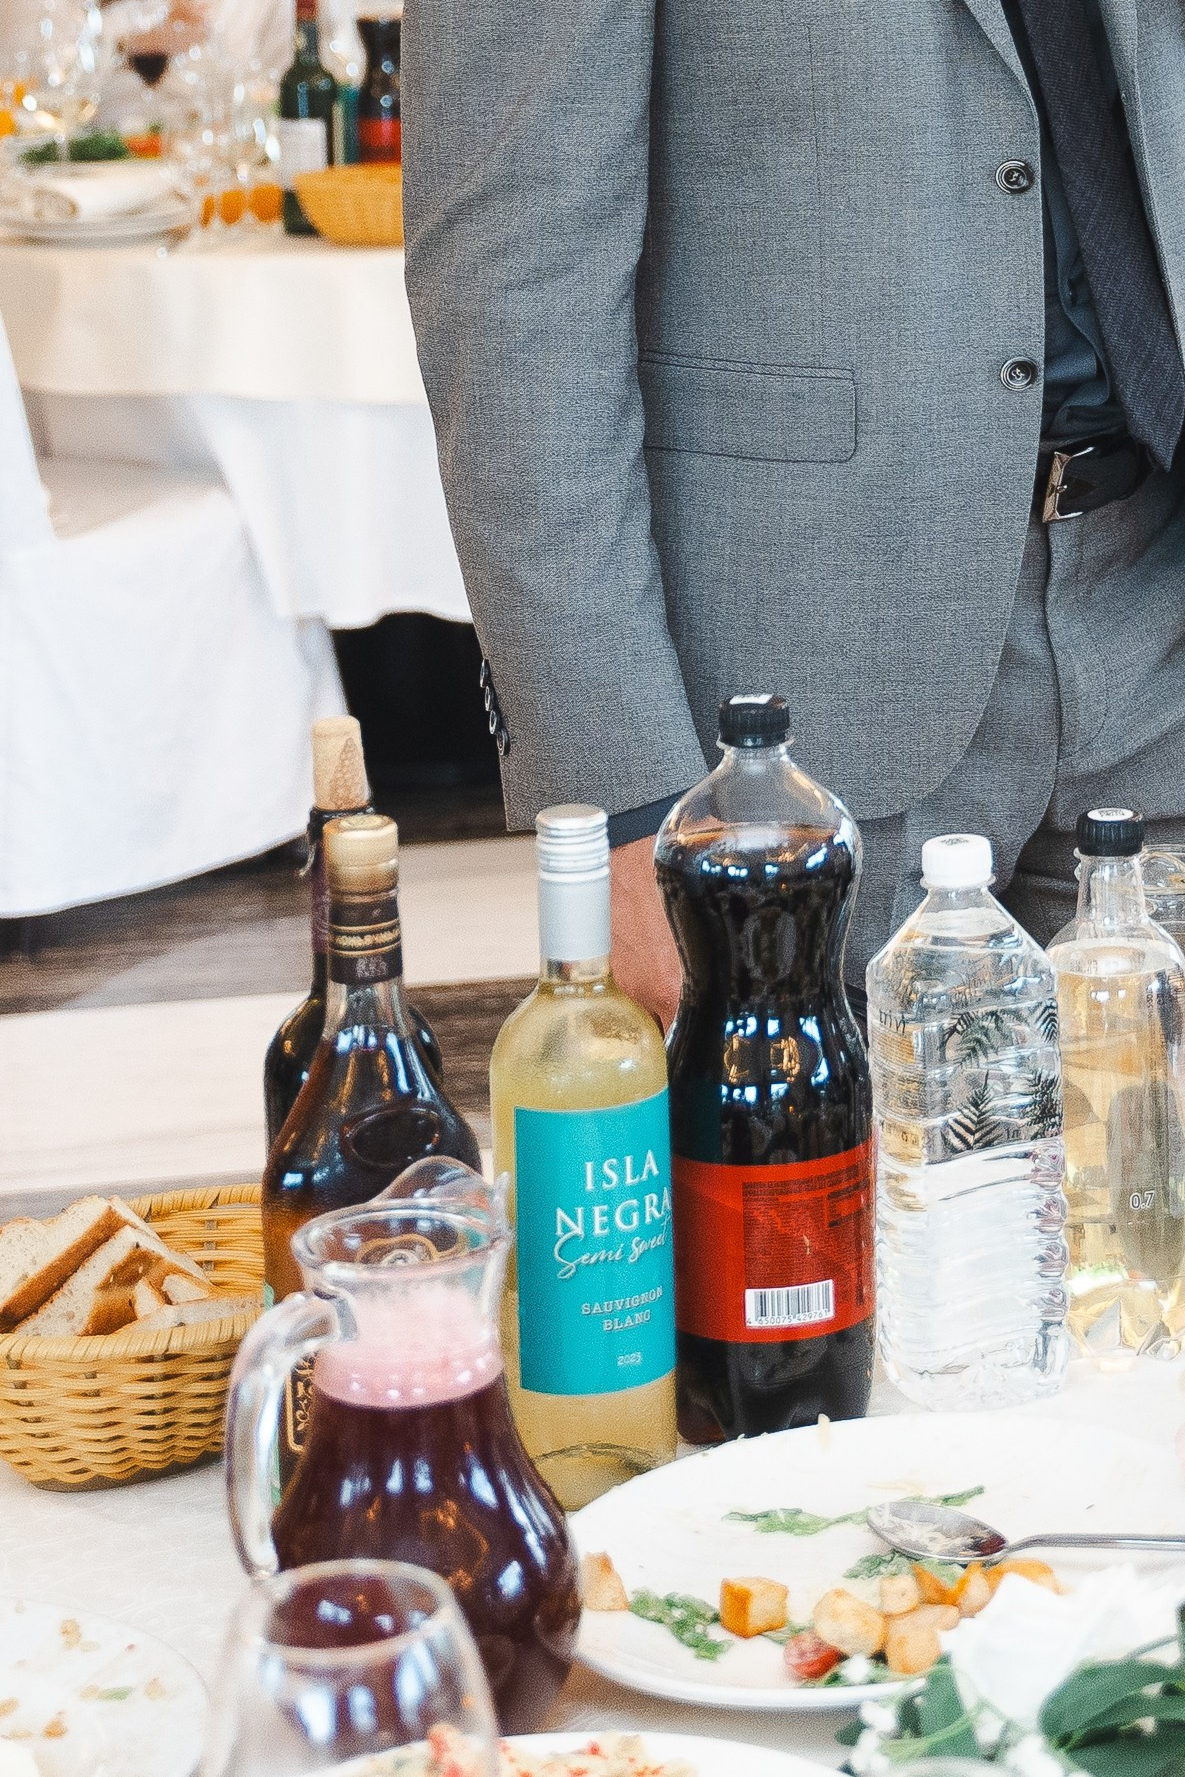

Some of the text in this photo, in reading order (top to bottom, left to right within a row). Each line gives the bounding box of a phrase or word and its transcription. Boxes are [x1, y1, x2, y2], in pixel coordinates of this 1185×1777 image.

[585, 1149, 659, 1192] ISLA
[555, 1186, 672, 1237] NEGRA
[1130, 1191, 1154, 1209] 0.7
[554, 1230, 624, 1280] Semi
[581, 1285, 664, 1316] SAUVIGNON
[602, 1308, 652, 1332] BLANC
[758, 1316, 792, 1326] 650075
[797, 1309, 828, 1322] 429761
